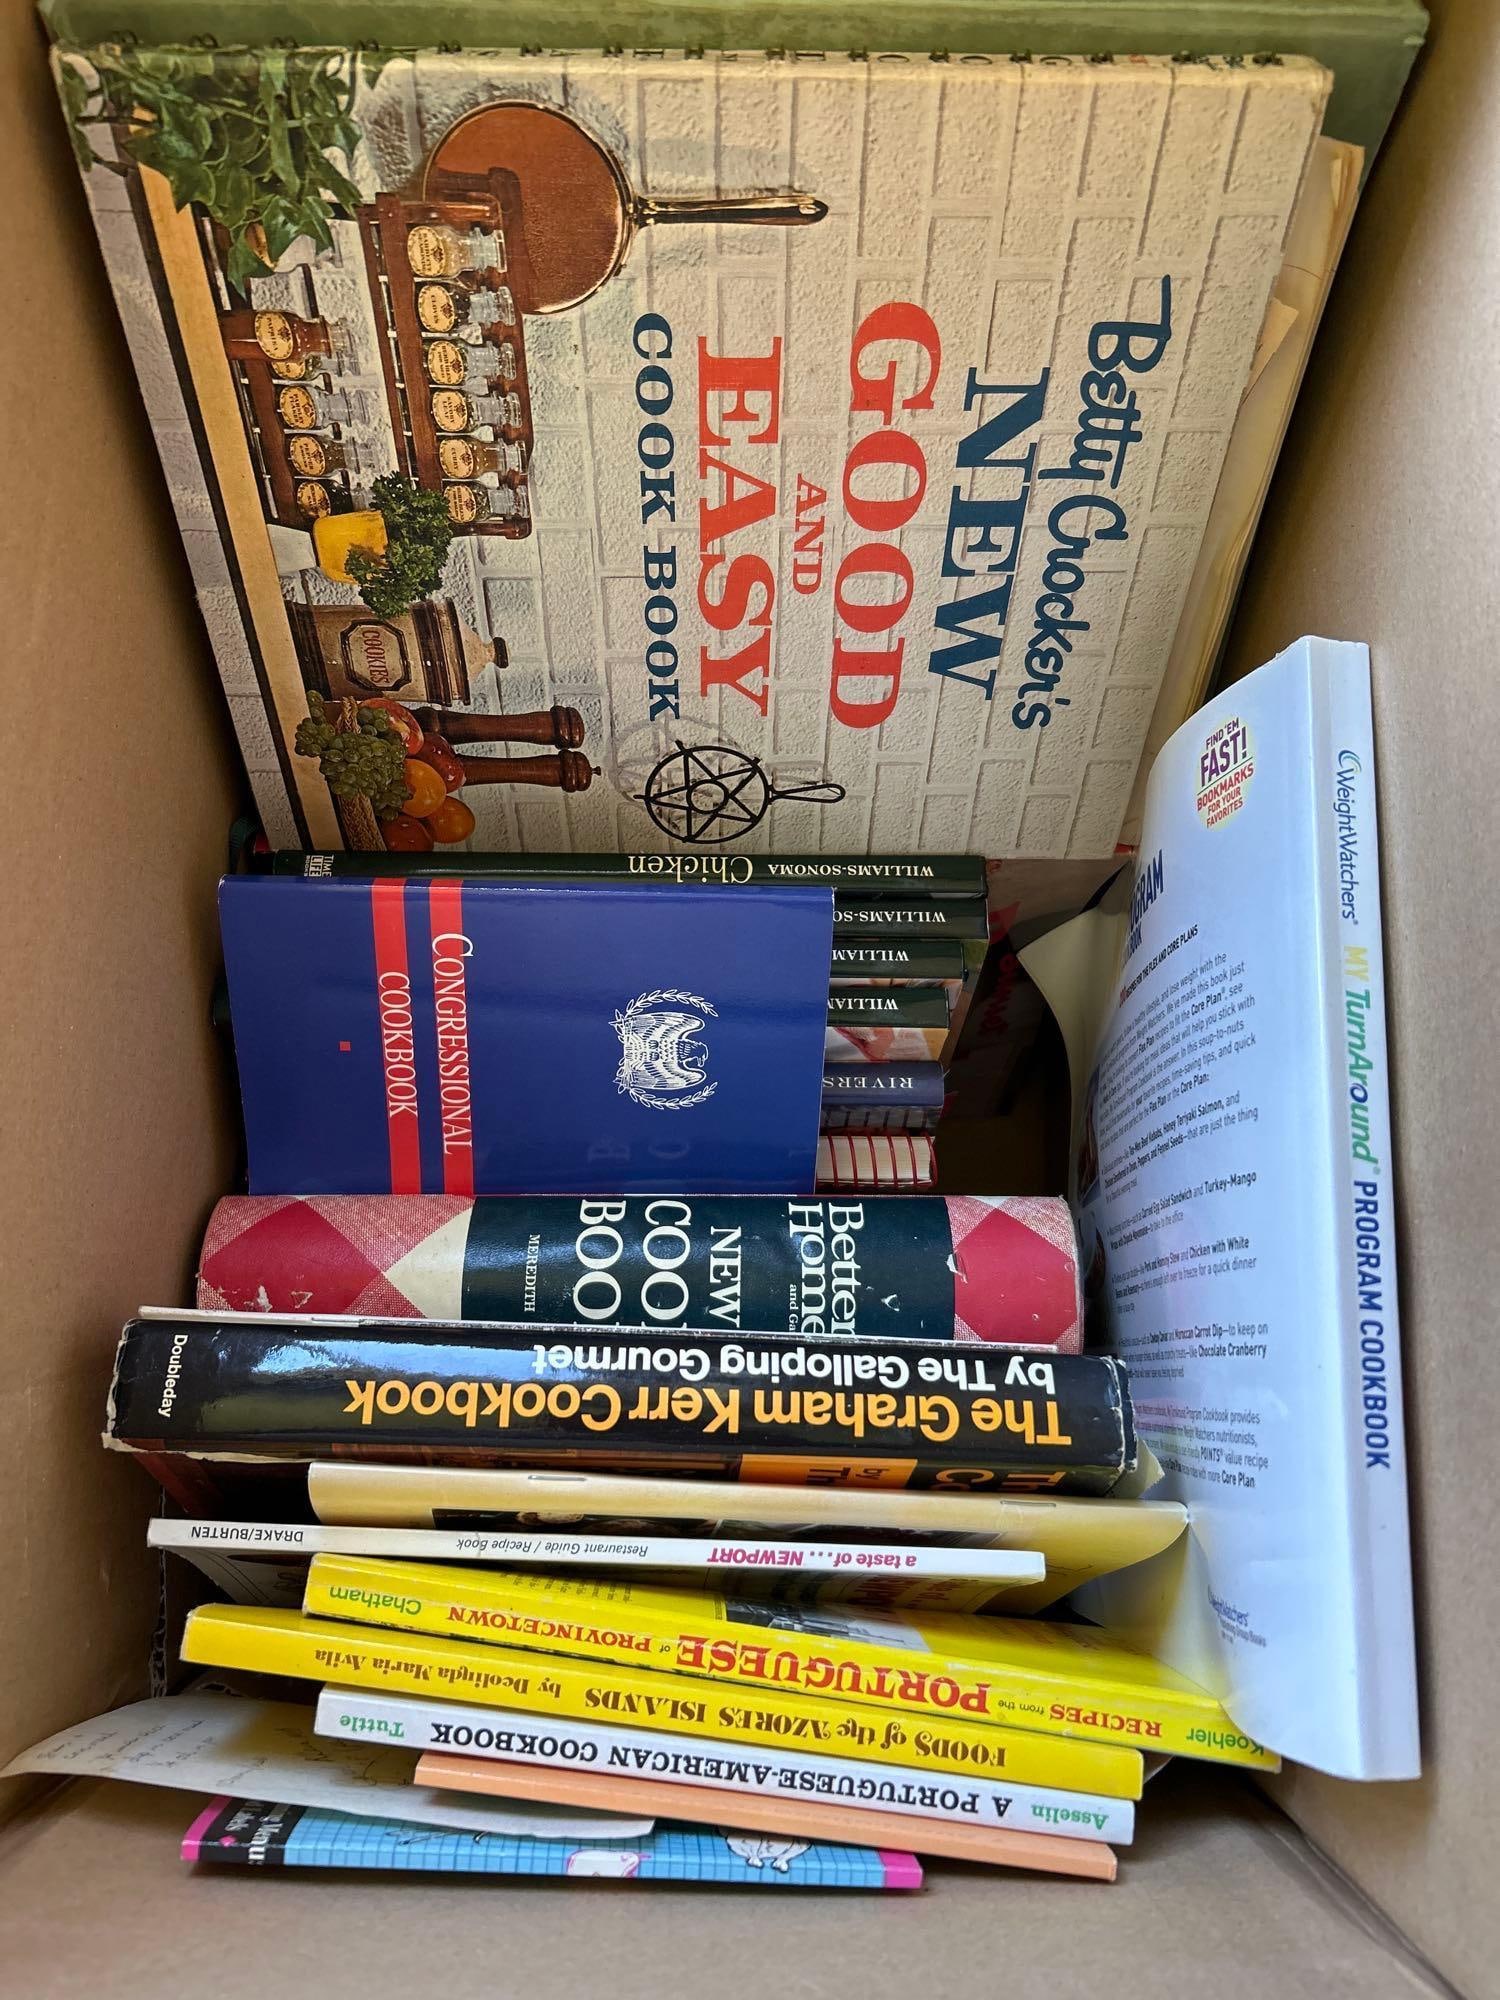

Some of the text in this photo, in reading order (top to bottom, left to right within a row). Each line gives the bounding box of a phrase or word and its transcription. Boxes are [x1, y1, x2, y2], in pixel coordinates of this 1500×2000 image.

[431, 295, 439, 324] CLOVES
[451, 447, 459, 470] CURRY
[632, 312, 680, 721] COOK BOOK
[830, 302, 941, 729] GOOD
[1011, 274, 1171, 730] Betty Crocker's
[697, 336, 782, 717] EASY
[792, 473, 827, 595] AND
[928, 366, 1051, 700] NEW
[362, 630, 390, 683] COOKIES
[1205, 717, 1240, 750] FIND 'EM
[1200, 727, 1247, 787] FAST!
[1197, 762, 1254, 812] BOOKMARKS
[1208, 787, 1241, 815] FOR YOUR
[1206, 797, 1243, 828] FAVORITES
[310, 855, 323, 877] LIFE
[322, 854, 334, 877] TIME
[628, 855, 753, 883] Chicken
[768, 863, 935, 877] WILLIAMS-SONOMA
[832, 949, 910, 961] WILLIAM
[1166, 934, 1180, 955] CORE
[1180, 924, 1199, 946] PLANS
[1169, 952, 1227, 995] lose weight with the
[1344, 945, 1369, 981] MY
[1181, 960, 1245, 1006] made this book just
[1181, 982, 1243, 1022] the Core see
[1171, 994, 1256, 1044] that will help you stick with
[379, 971, 419, 1118] COOKBOOK
[432, 933, 474, 1155] CONGRESSIONAL
[1187, 1019, 1245, 1053] this soup-to-nuts
[1218, 1039, 1232, 1055] and
[1234, 1031, 1256, 1050] quick
[823, 1076, 914, 1089] RIVERS
[1172, 1072, 1209, 1099] the Core Plan:
[1176, 1090, 1240, 1127] Teriyaki Salmon, and
[1199, 1106, 1258, 1136] are just the thing
[1170, 1171, 1257, 1205] Sandwich and Turkey-Mango
[1189, 1236, 1249, 1262] Chicken with White
[1353, 1180, 1383, 1311] PROGRAM
[524, 1234, 541, 1312] MEREDITH
[573, 1199, 627, 1327] BOO
[641, 1200, 692, 1327] COO
[708, 1226, 742, 1328] NEW
[788, 1201, 826, 1333] Home
[828, 1202, 865, 1335] Better
[1199, 1257, 1257, 1276] for a quick dinner
[789, 1283, 799, 1310] and
[1195, 1322, 1268, 1341] Carrot keep on
[1199, 1343, 1227, 1358] Chocolate
[1228, 1342, 1267, 1359] Cranberry
[158, 1334, 189, 1418] Doubleday
[531, 1344, 1056, 1395] by The Galloping Gourmet
[1359, 1319, 1390, 1469] COOKBOOK
[342, 1379, 1072, 1445] The Graham Kerr Cookbook
[1202, 1407, 1228, 1422] Cookbook
[1230, 1409, 1261, 1426] provides
[1216, 1428, 1258, 1447] nutritionists,
[1225, 1452, 1269, 1470] value recipe
[1207, 1469, 1255, 1488] more Core Plan
[191, 1526, 304, 1543] DRAKE/BURTEN
[456, 1538, 648, 1557] Restaurant Guide / Recipe Book
[707, 1547, 917, 1568] a taste NEWPORT
[329, 1585, 422, 1616] Chatham
[315, 1649, 366, 1670] Avila
[372, 1657, 432, 1681] Maria
[448, 1606, 1163, 1738] RECIPES from the PORTUGUESE of PROVINCETOWN
[538, 1677, 561, 1698] by
[585, 1687, 706, 1722] ISLANDS
[340, 1714, 404, 1738] Tuttle
[719, 1706, 832, 1741] AZORES
[837, 1717, 875, 1746] the
[880, 1720, 907, 1750] of
[914, 1731, 1006, 1768] FOODS
[1186, 1727, 1264, 1756] Koehler
[430, 1722, 1013, 1817] A PORTUGUESE-AMERICAN COOKBOOK
[1031, 1803, 1109, 1831] Asselin
